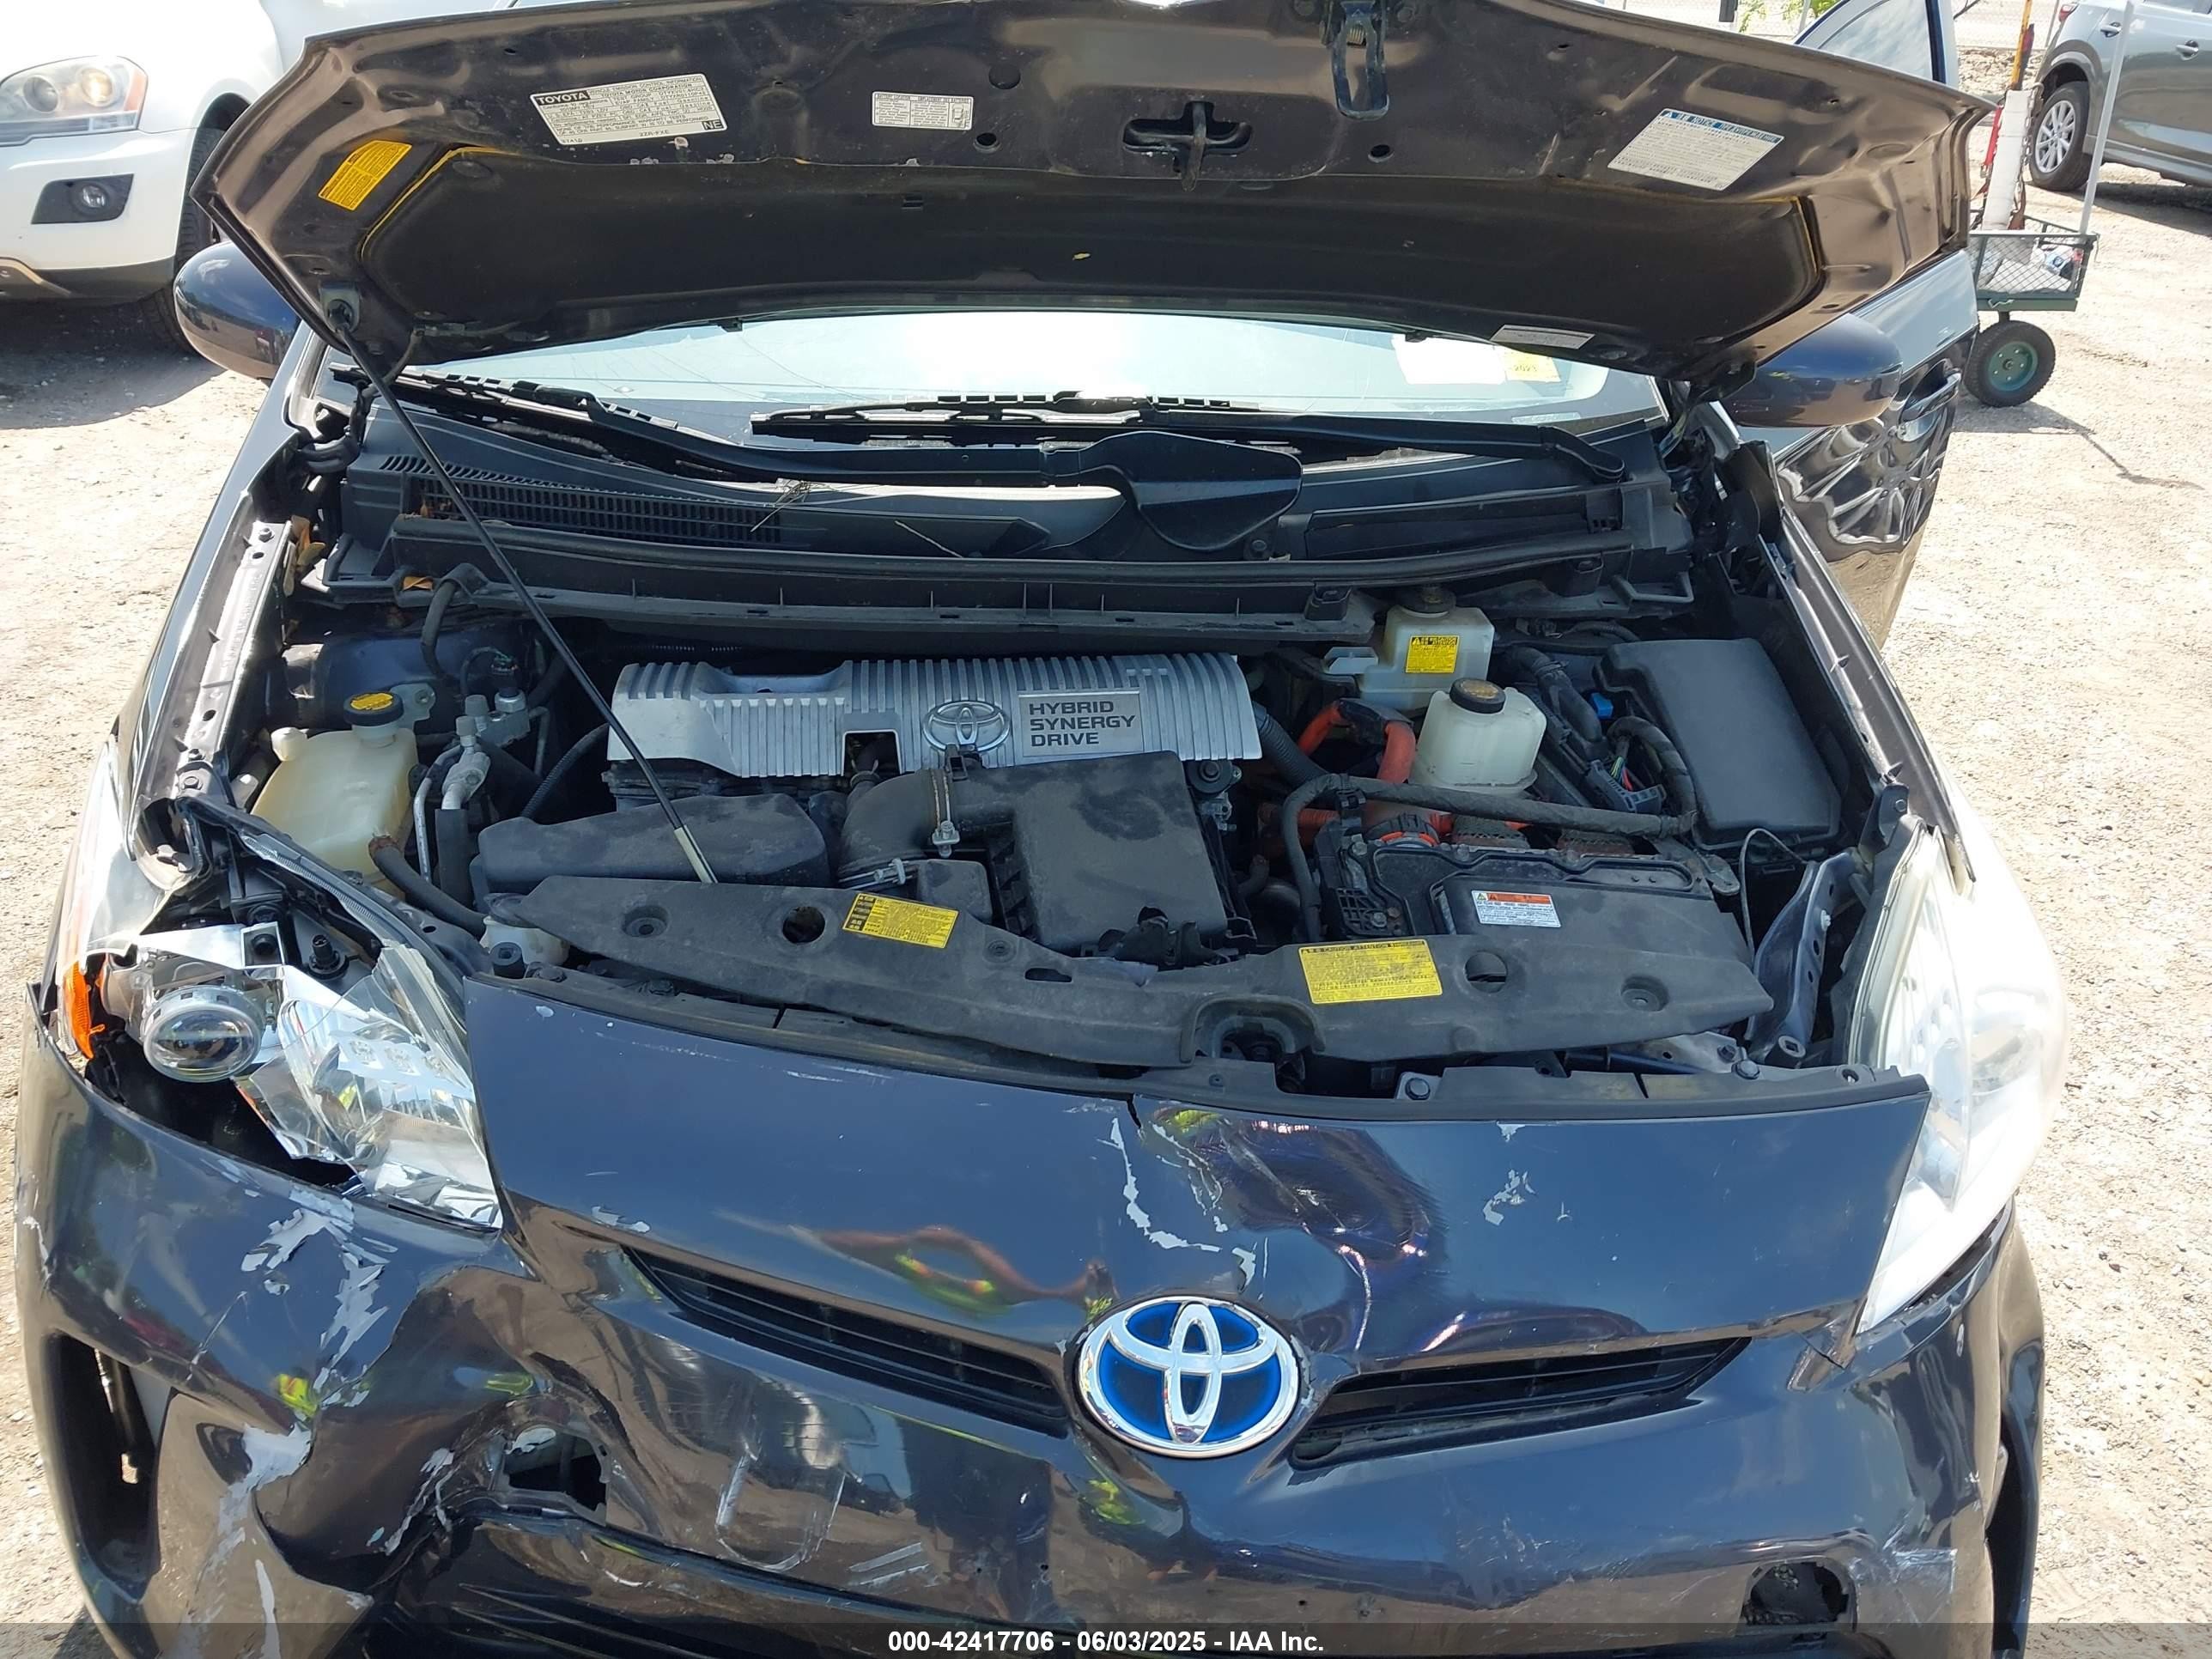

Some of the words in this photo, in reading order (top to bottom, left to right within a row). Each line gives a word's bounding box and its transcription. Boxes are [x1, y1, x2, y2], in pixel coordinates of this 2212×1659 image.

[649, 83, 693, 92] CORPORATION
[537, 93, 589, 105] TOYOTA
[703, 120, 724, 131] NE
[1030, 700, 1114, 715] HYBRID
[1030, 715, 1136, 732] SYNERGY
[1031, 732, 1100, 747] DRIVE
